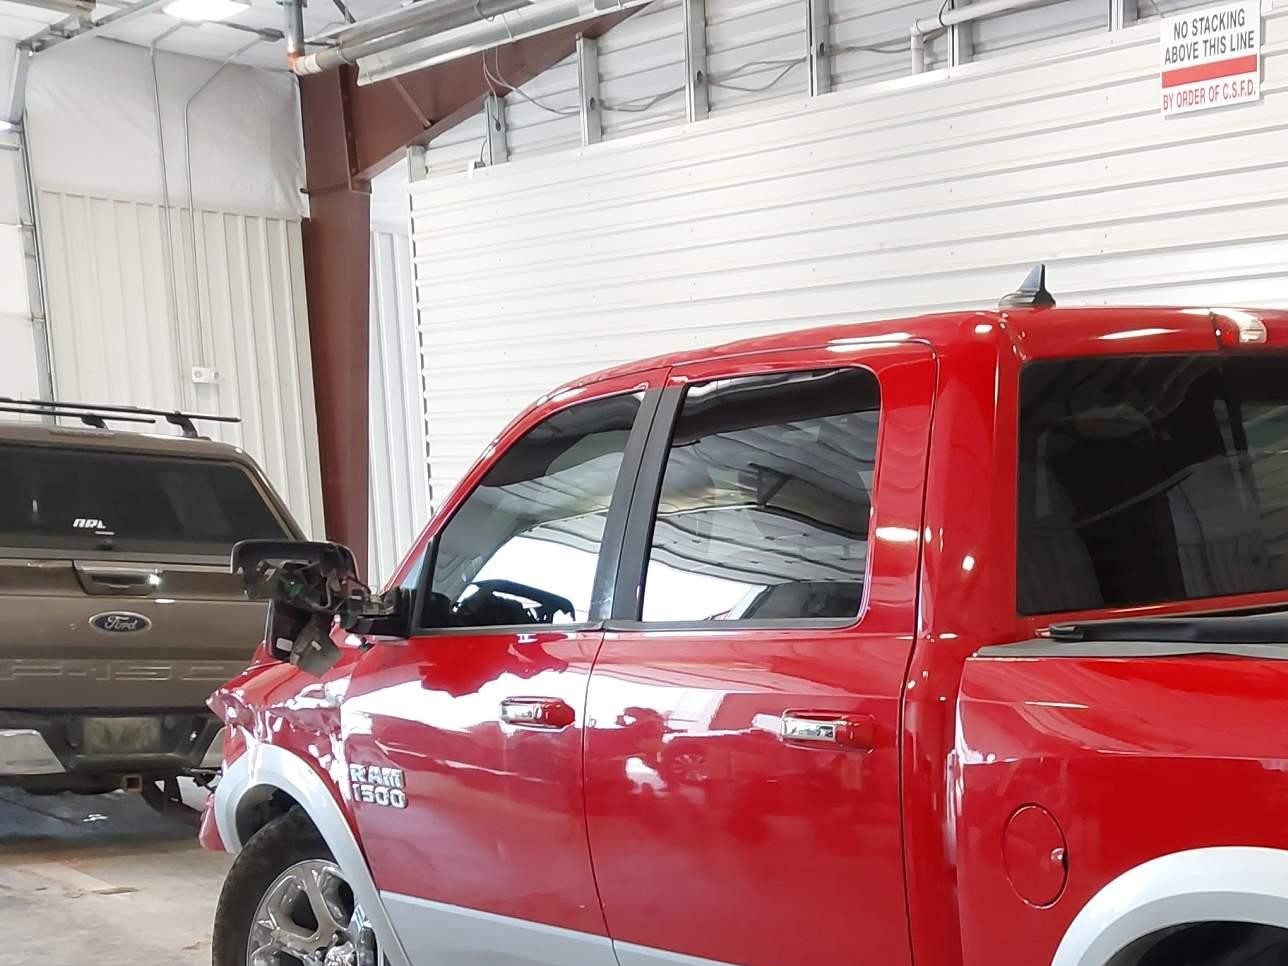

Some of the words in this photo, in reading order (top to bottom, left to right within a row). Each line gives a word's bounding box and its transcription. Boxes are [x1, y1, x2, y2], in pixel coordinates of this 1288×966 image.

[1174, 21, 1188, 41] NO
[1192, 8, 1245, 37] STACKING
[1165, 41, 1199, 65] ABOVE
[1203, 35, 1226, 57] THIS
[1230, 30, 1255, 52] LINE
[1163, 94, 1174, 111] BY
[1177, 87, 1205, 108] ORDER
[1208, 84, 1220, 103] OF
[1223, 79, 1257, 101] C.S.F.D.
[103, 614, 139, 630] Ford
[349, 763, 406, 789] RAM
[351, 783, 409, 809] 1500
